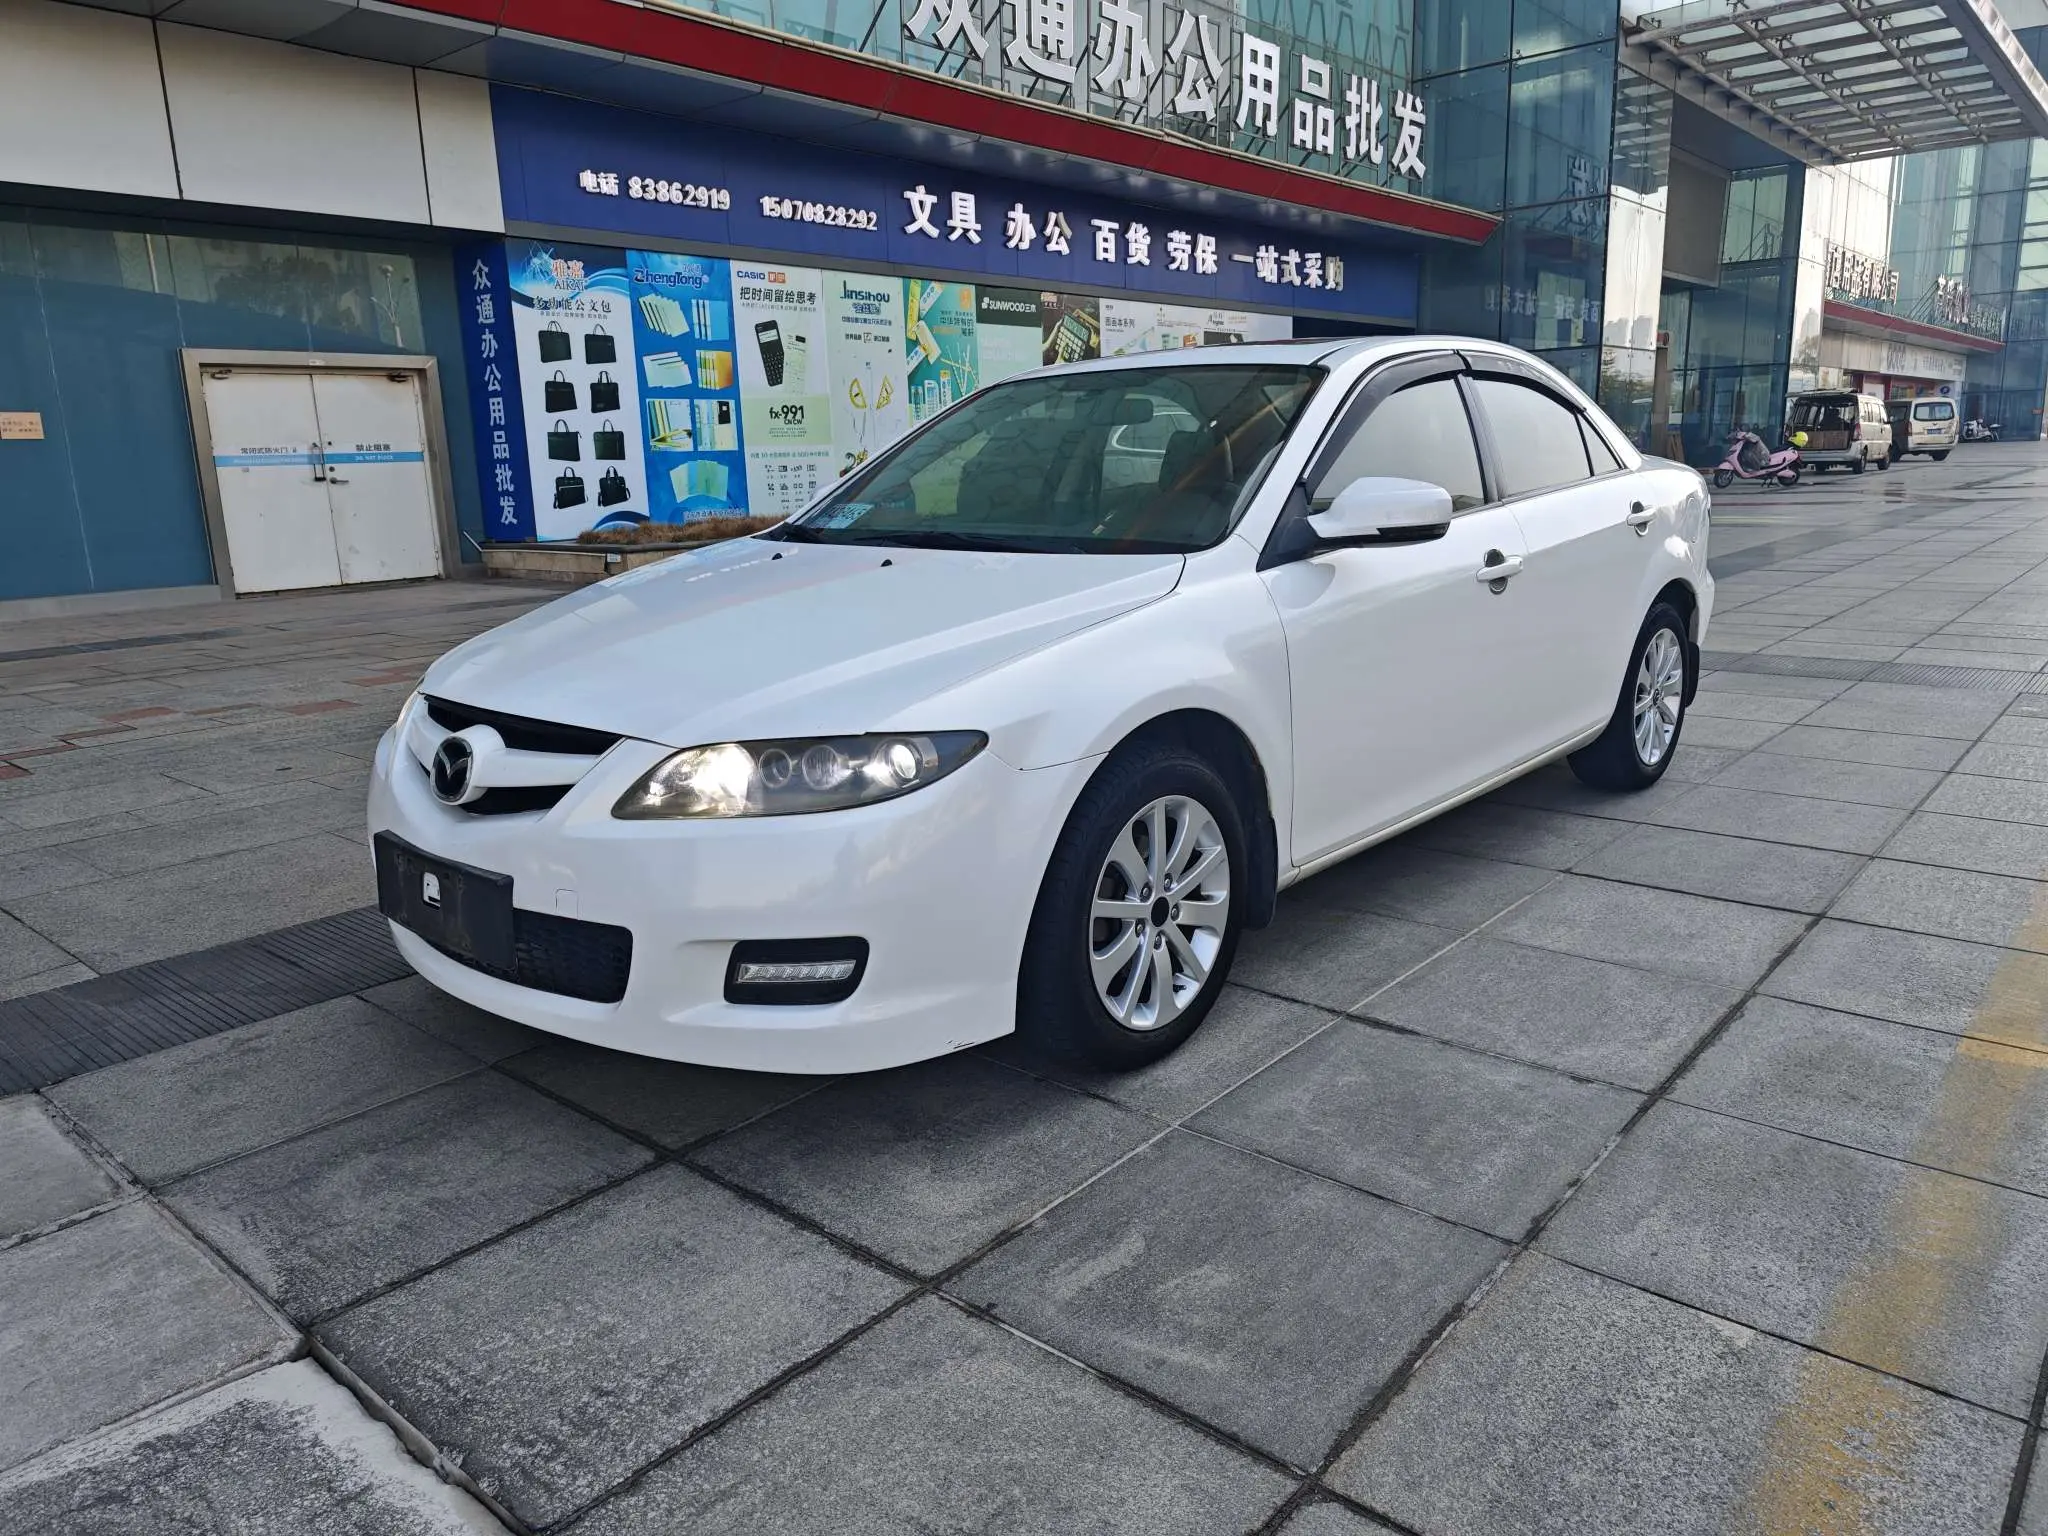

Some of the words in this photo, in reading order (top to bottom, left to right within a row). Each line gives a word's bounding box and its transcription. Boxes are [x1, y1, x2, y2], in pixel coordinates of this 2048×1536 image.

[578, 170, 619, 197] 电话
[627, 176, 731, 210] 83862919
[759, 196, 879, 231] 15070828292
[903, 184, 982, 245] 文具
[1005, 202, 1073, 256] 办公
[1090, 217, 1152, 267] 百货
[1166, 230, 1218, 275] 劳保
[1231, 244, 1344, 292] 一站式采购
[736, 270, 766, 280] CASIO
[533, 296, 612, 313] 多功能公文包
[740, 286, 817, 305] 把时间留给思考
[989, 300, 1025, 312] SUNWOOD
[1024, 304, 1036, 313] 三木
[471, 258, 518, 526] 众通办公用品批发
[769, 404, 805, 419] fx-991
